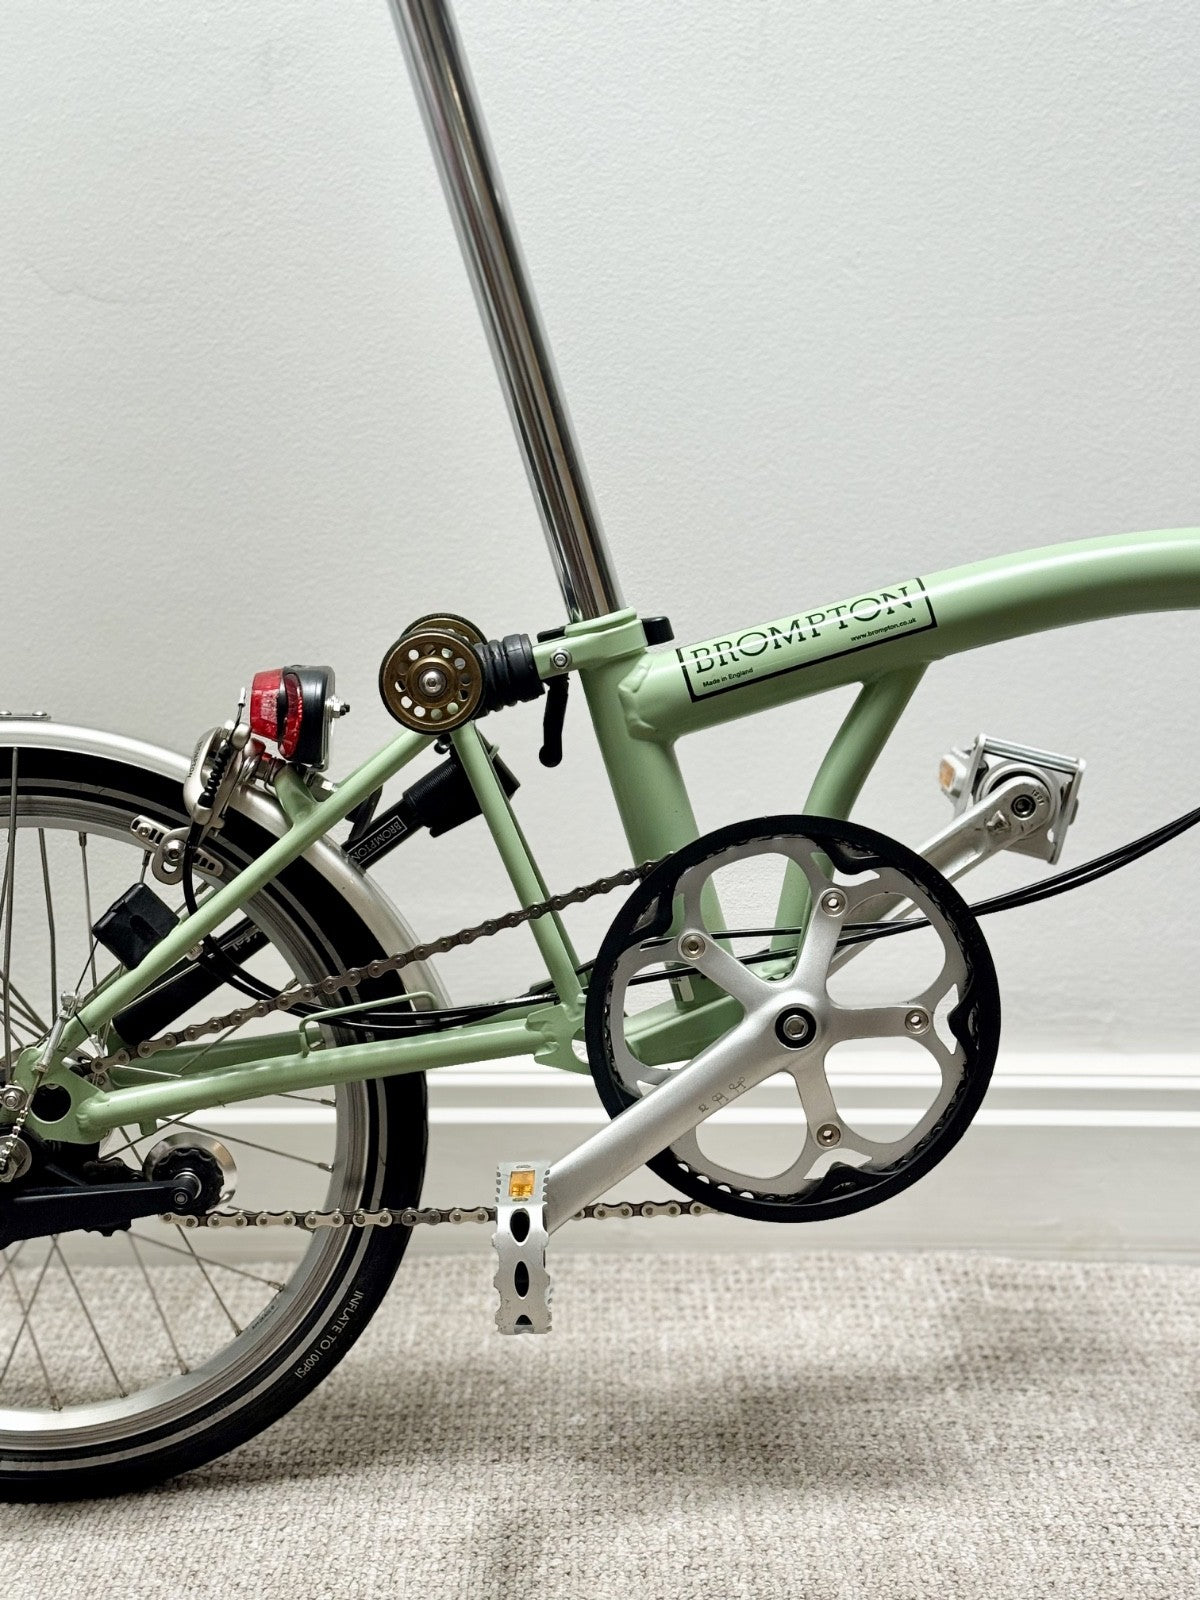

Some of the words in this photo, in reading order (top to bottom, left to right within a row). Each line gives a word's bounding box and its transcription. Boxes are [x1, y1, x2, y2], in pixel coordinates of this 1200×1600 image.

[690, 586, 914, 674] BROMPTON
[850, 617, 917, 642] www.brompton.co.uk
[702, 679, 721, 688] Made
[728, 667, 754, 680] England
[351, 821, 402, 860] BROMPTON
[331, 1290, 365, 1334] INFLATE
[320, 1334, 338, 1351] TO
[294, 1349, 324, 1379] 100PSI
